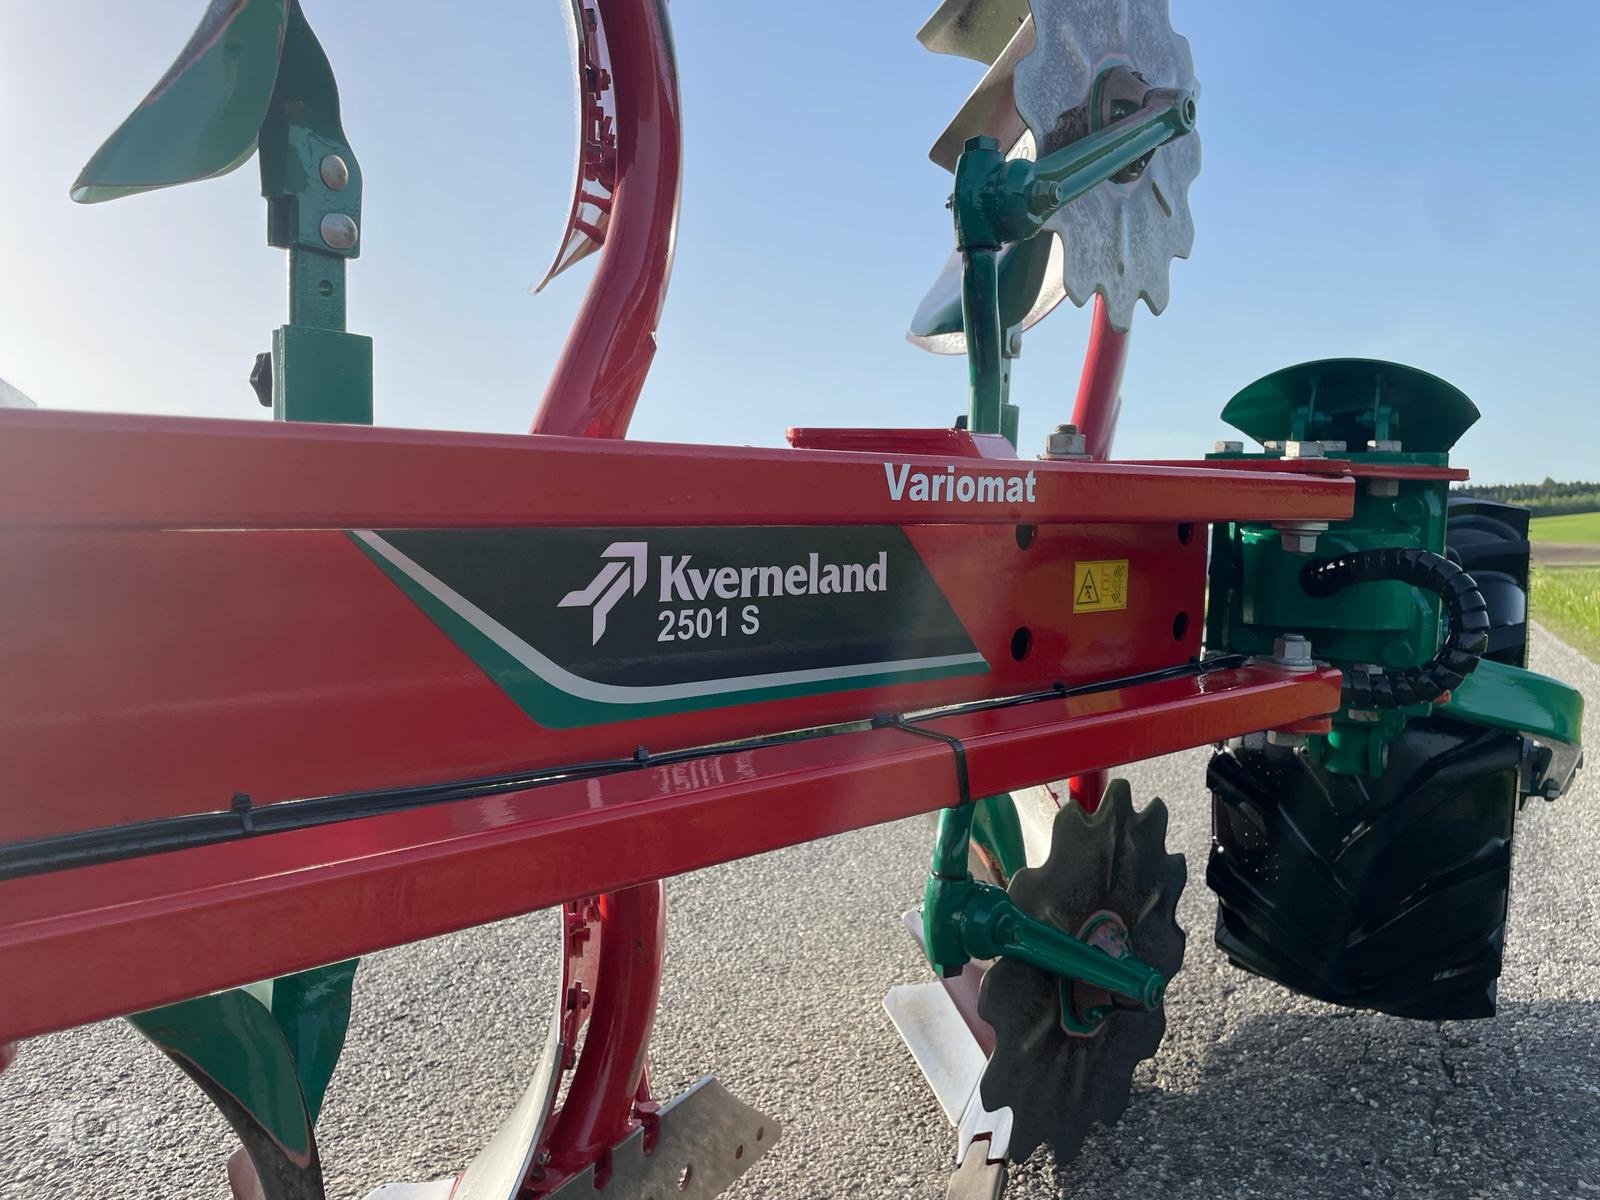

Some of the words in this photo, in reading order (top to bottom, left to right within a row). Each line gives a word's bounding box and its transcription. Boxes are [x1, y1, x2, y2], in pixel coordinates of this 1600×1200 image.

[884, 462, 1037, 504] Variomat
[658, 551, 888, 603] Kverneland
[657, 606, 729, 643] 2501
[740, 604, 761, 636] S
